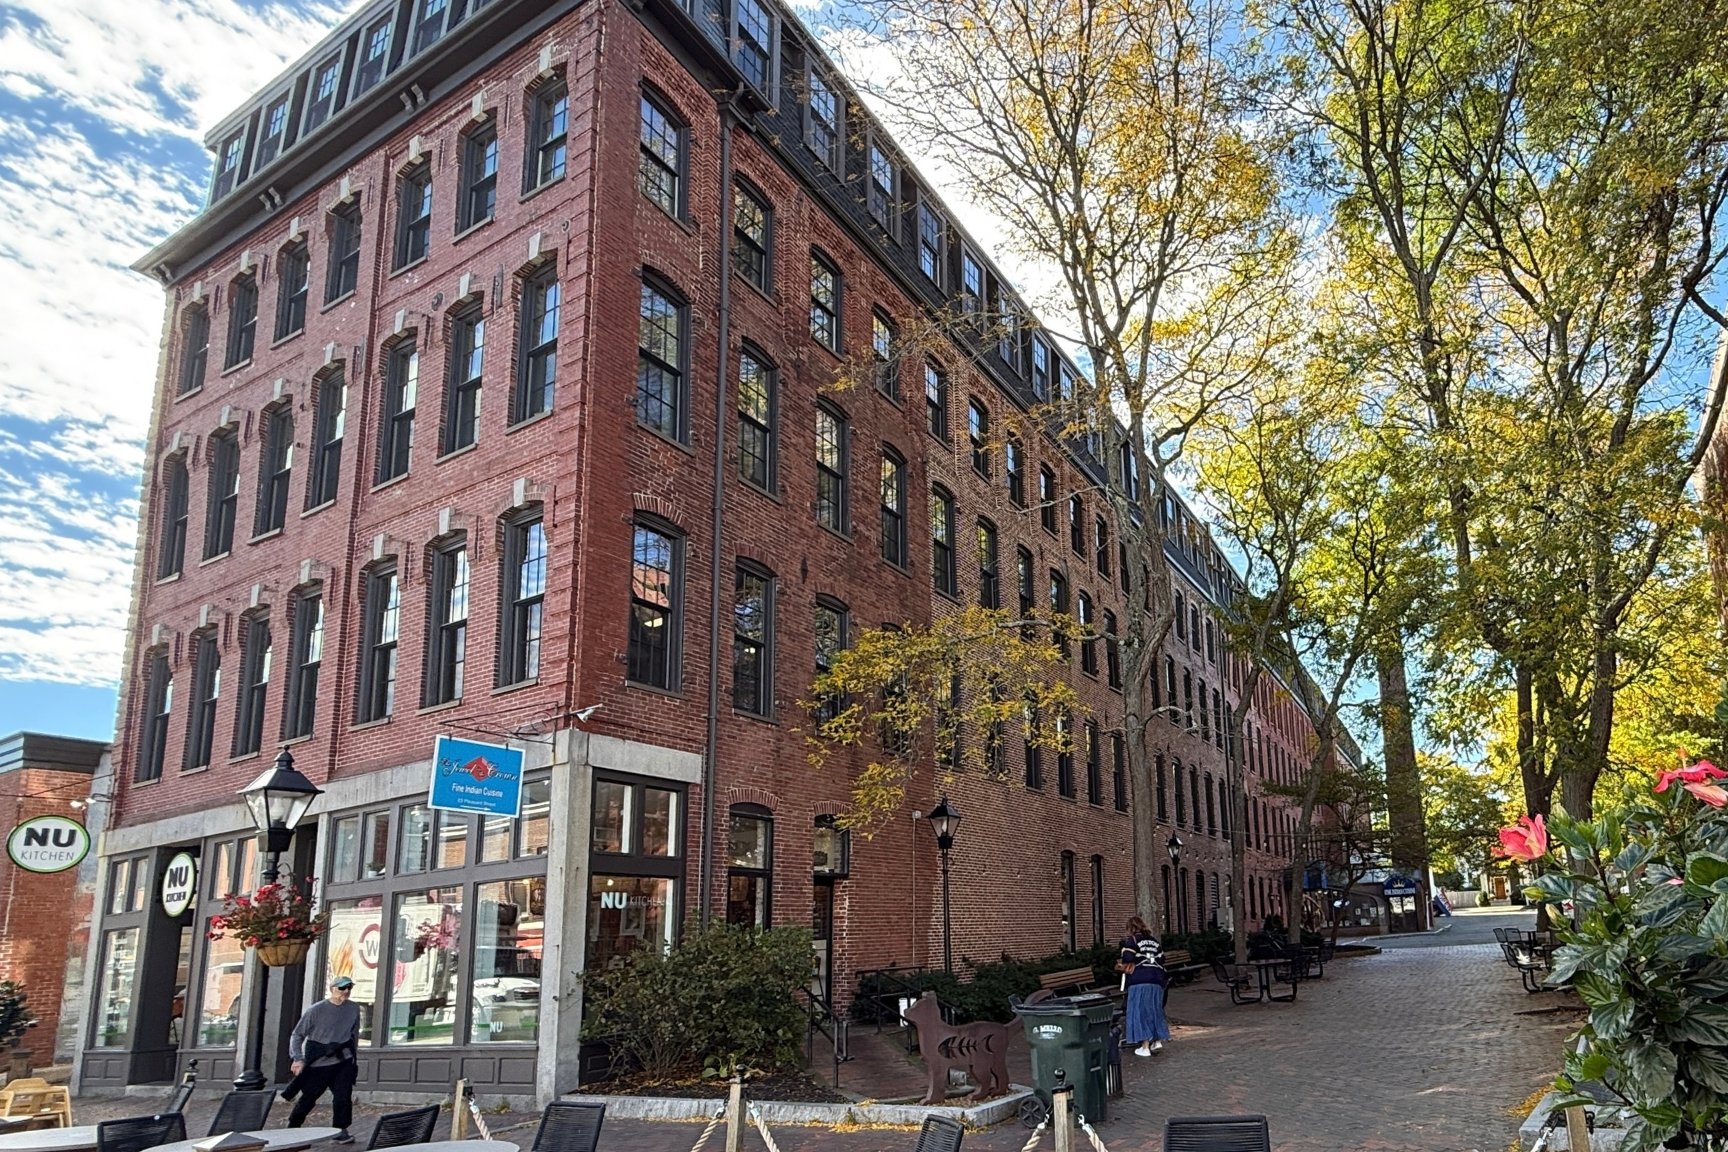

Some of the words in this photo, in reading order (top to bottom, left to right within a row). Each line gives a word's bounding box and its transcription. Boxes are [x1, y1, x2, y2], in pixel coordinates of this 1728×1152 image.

[487, 762, 518, 781] Crown
[452, 782, 464, 793] Fine
[465, 785, 482, 795] Indian
[483, 787, 503, 798] Cuisine
[24, 827, 77, 847] NU
[21, 851, 75, 861] KITCHEN
[168, 865, 189, 889] NU
[601, 892, 628, 909] NU
[1137, 940, 1160, 948] BOSTON
[490, 1021, 503, 1033] NU
